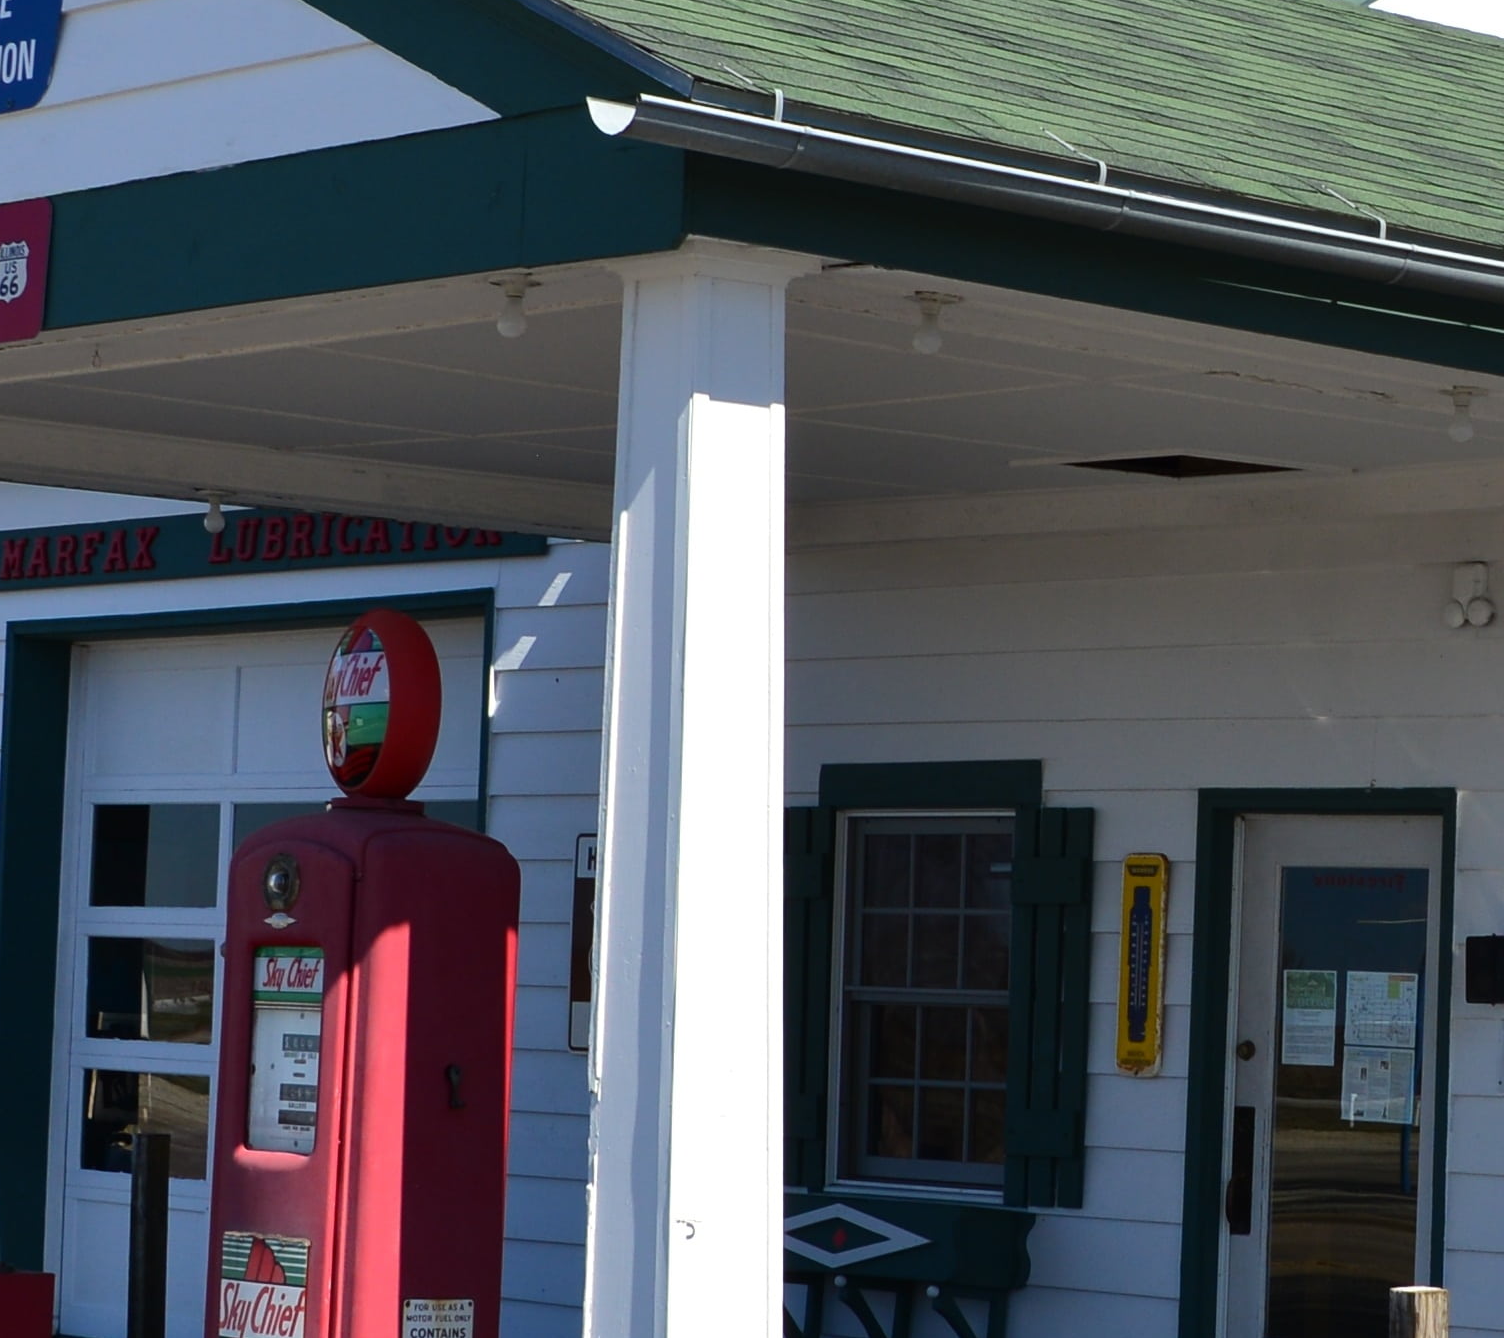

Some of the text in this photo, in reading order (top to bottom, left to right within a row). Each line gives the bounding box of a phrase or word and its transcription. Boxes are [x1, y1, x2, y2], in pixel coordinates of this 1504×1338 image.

[0, 241, 30, 259] ILLINOIS
[3, 261, 18, 274] US
[0, 525, 161, 580] MARFAX
[340, 653, 385, 698] Chief
[263, 956, 321, 992] Sky Chief
[252, 1286, 307, 1338] Chief
[414, 1303, 465, 1311] FOR USE AS A
[406, 1314, 433, 1322] MOTOR
[454, 1314, 471, 1322] ONLY
[410, 1327, 466, 1338] CONTAINS
